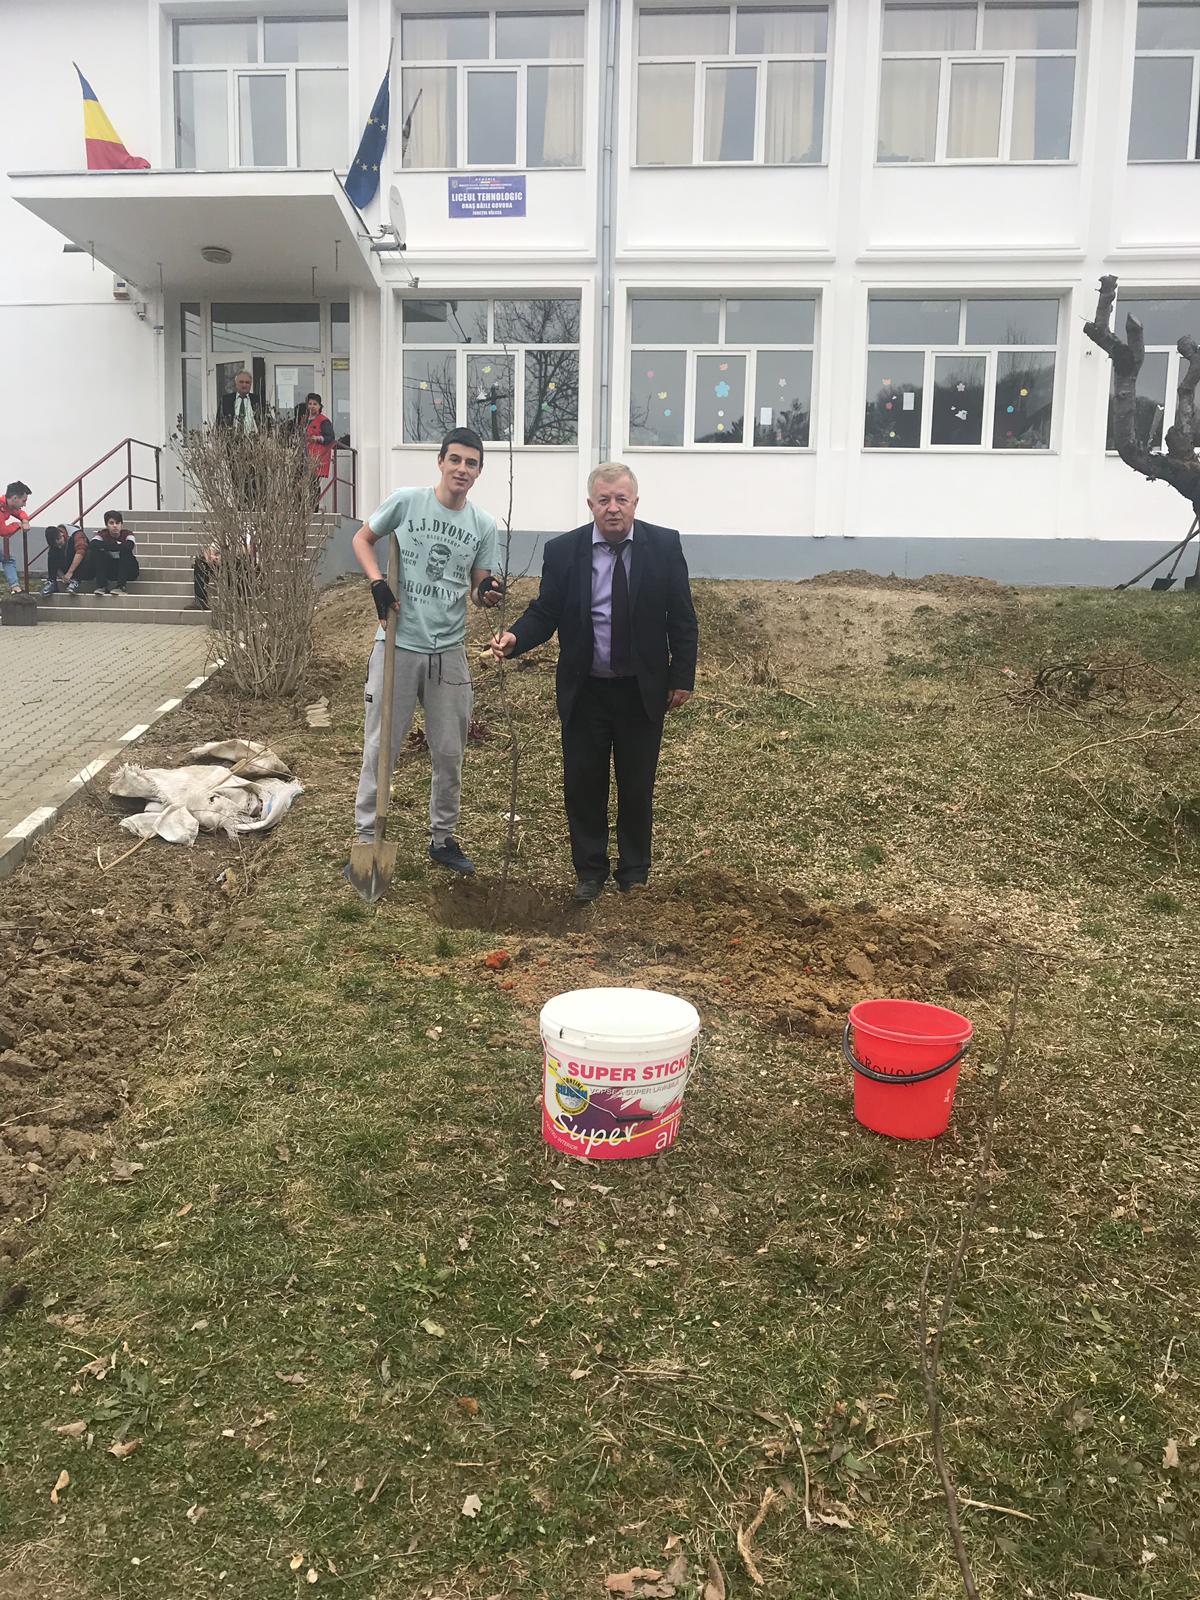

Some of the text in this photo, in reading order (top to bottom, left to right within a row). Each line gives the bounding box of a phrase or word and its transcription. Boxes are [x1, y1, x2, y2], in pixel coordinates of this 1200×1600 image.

[451, 192, 523, 202] LICEUL TEHNOLOGIC
[567, 1061, 636, 1082] SUPER
[625, 1087, 652, 1096] SUPER
[553, 1112, 639, 1155] Super
